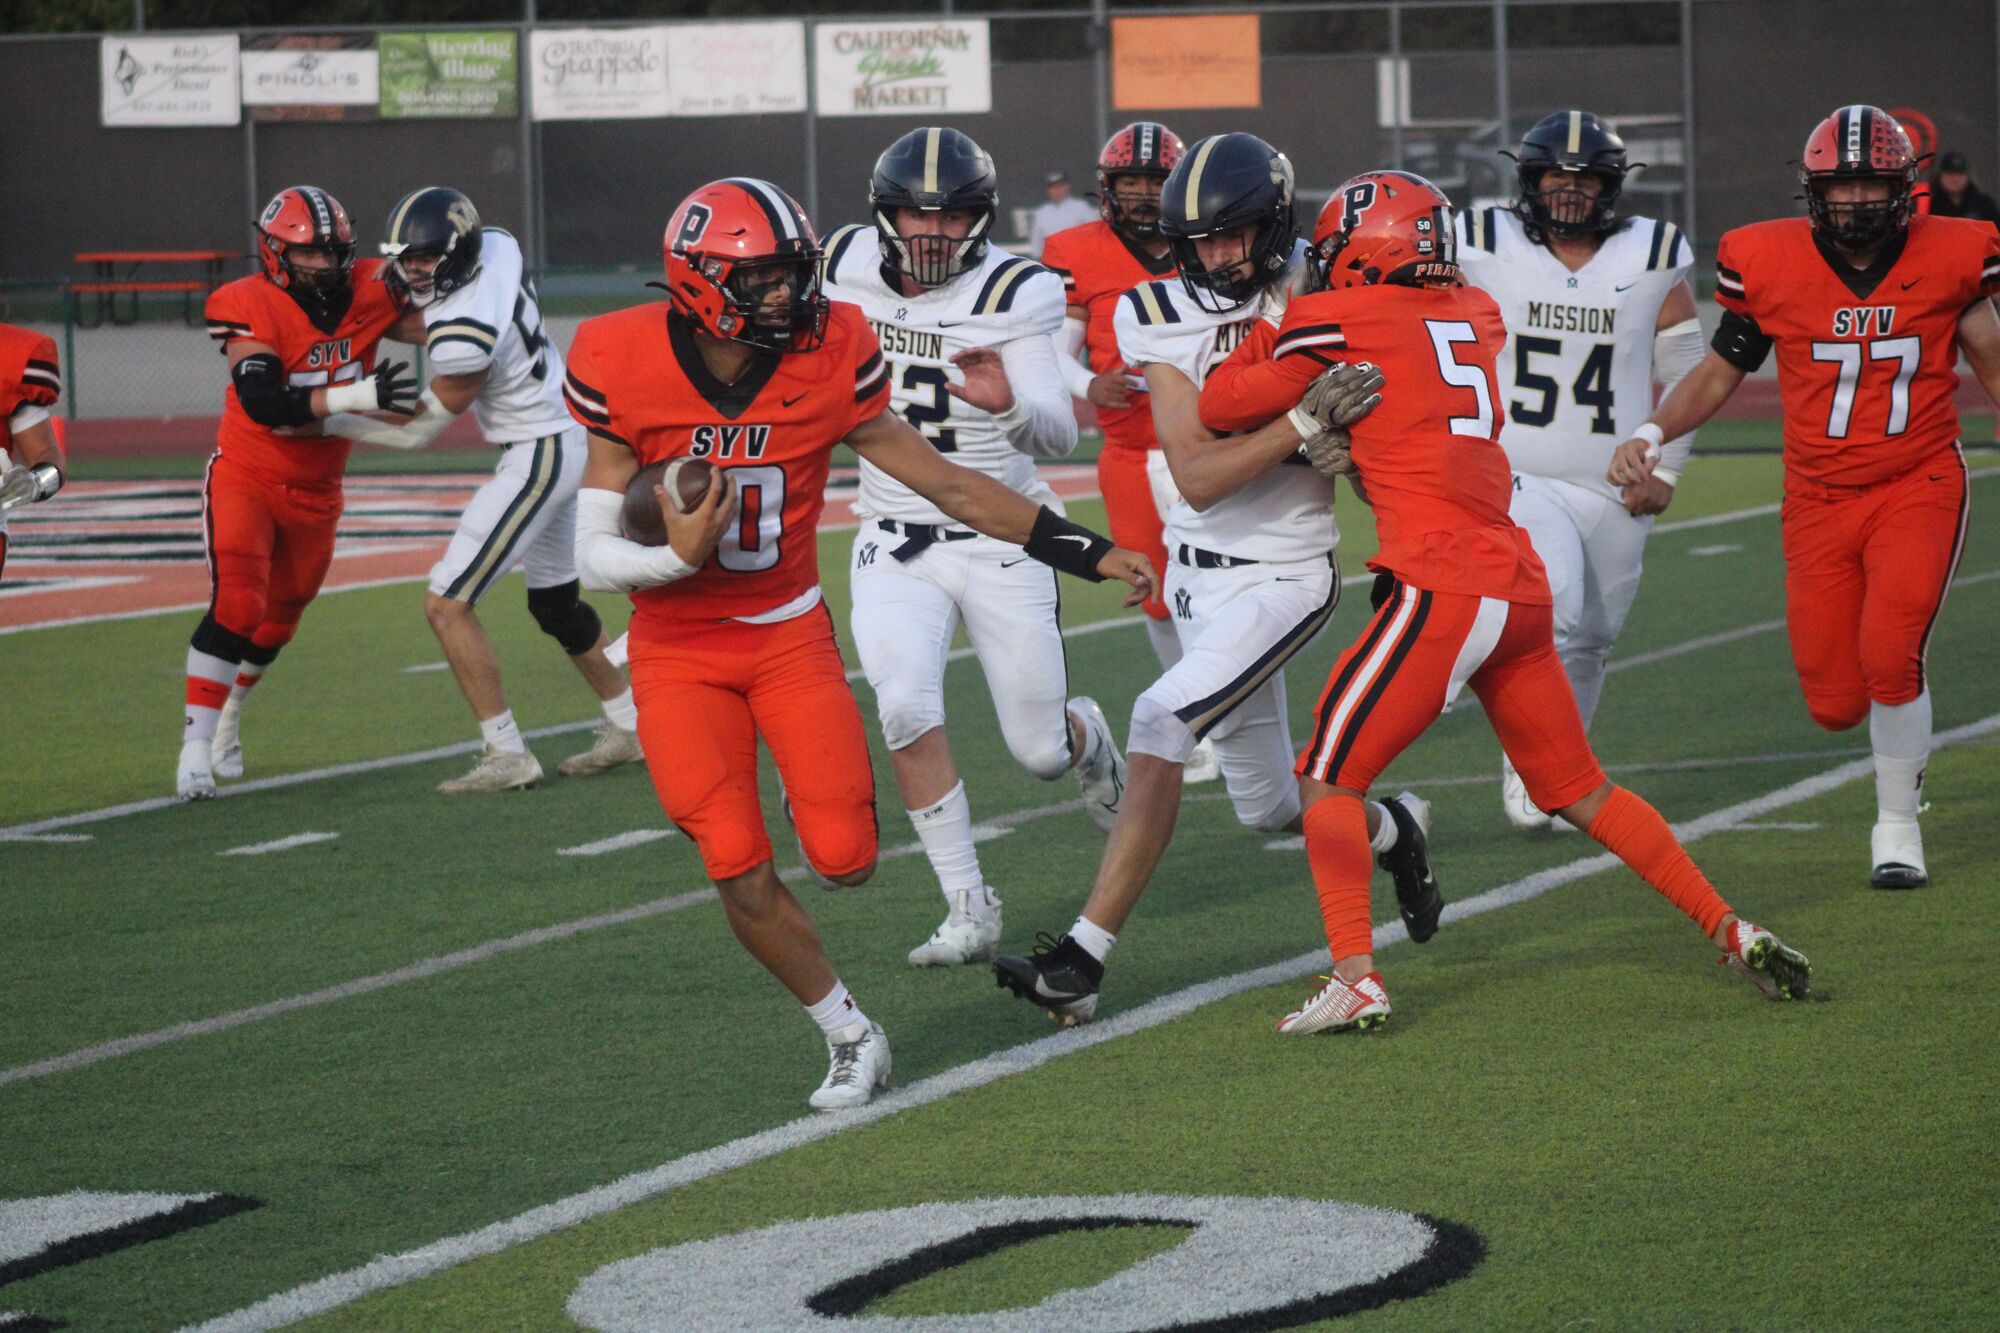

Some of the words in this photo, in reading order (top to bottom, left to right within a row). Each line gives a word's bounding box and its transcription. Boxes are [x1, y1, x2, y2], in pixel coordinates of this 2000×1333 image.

[834, 26, 971, 54] CALIFORNIA
[543, 38, 659, 85] Grappolo
[256, 71, 360, 87] PINOLI'S
[854, 85, 948, 110] MARKET
[1340, 181, 1378, 233] P
[671, 201, 713, 260] P
[1528, 301, 1616, 335] MISSION
[1833, 306, 1896, 337] SYV
[308, 338, 352, 368] SYV
[1424, 319, 1494, 440] 5
[1510, 331, 1617, 435] 54
[1811, 335, 1921, 439] 77
[691, 425, 772, 459] SYV
